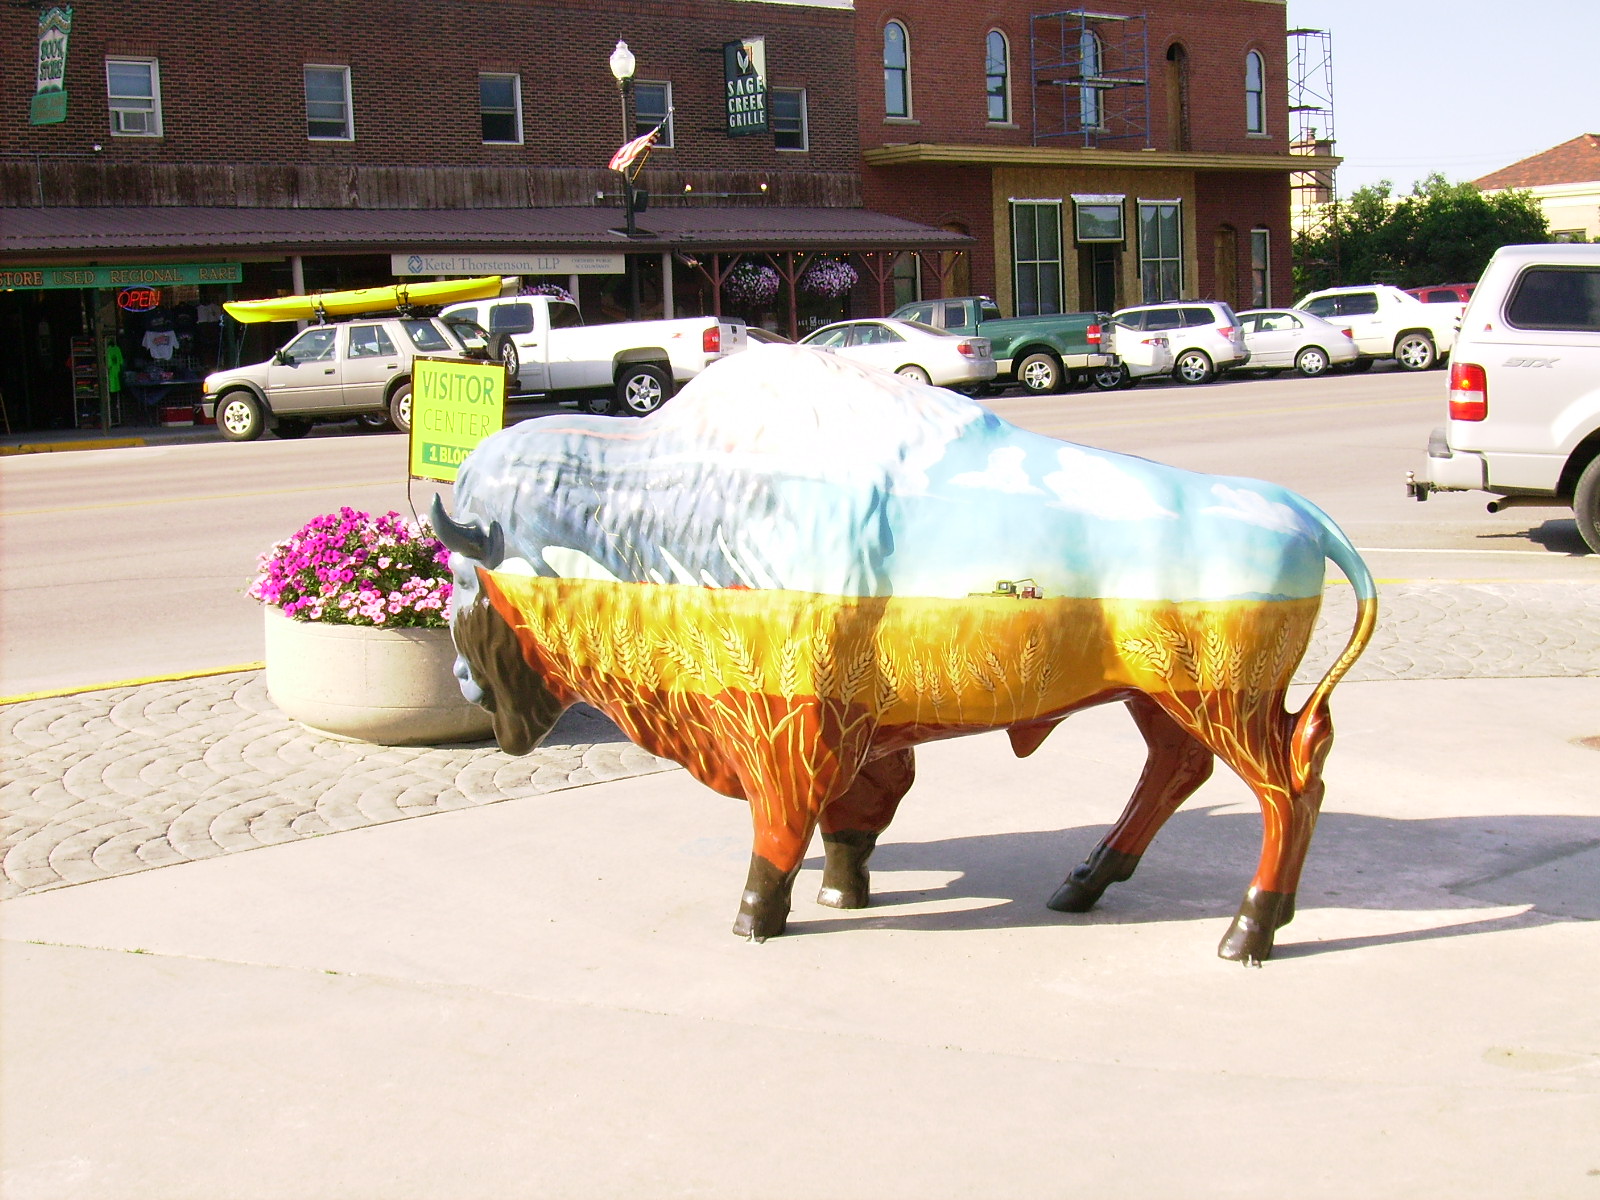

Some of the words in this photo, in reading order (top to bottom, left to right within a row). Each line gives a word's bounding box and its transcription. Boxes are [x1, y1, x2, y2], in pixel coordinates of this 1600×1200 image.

[40, 37, 64, 61] BOOK
[40, 60, 63, 81] STORE
[727, 75, 764, 98] SAGE
[728, 93, 765, 114] CREEK
[729, 108, 765, 128] GRILLE
[425, 257, 455, 271] Ketel
[459, 257, 533, 272] Thorstenson,
[538, 257, 560, 270] LLP
[53, 270, 95, 285] USED
[110, 268, 184, 283] REGIONAL
[199, 266, 237, 281] RARE
[117, 290, 160, 308] OPEN
[1502, 358, 1561, 368] STX
[422, 370, 495, 406] VISITOR
[423, 408, 490, 438] CENTER
[429, 445, 438, 462] 1
[439, 446, 473, 465] BLOC
